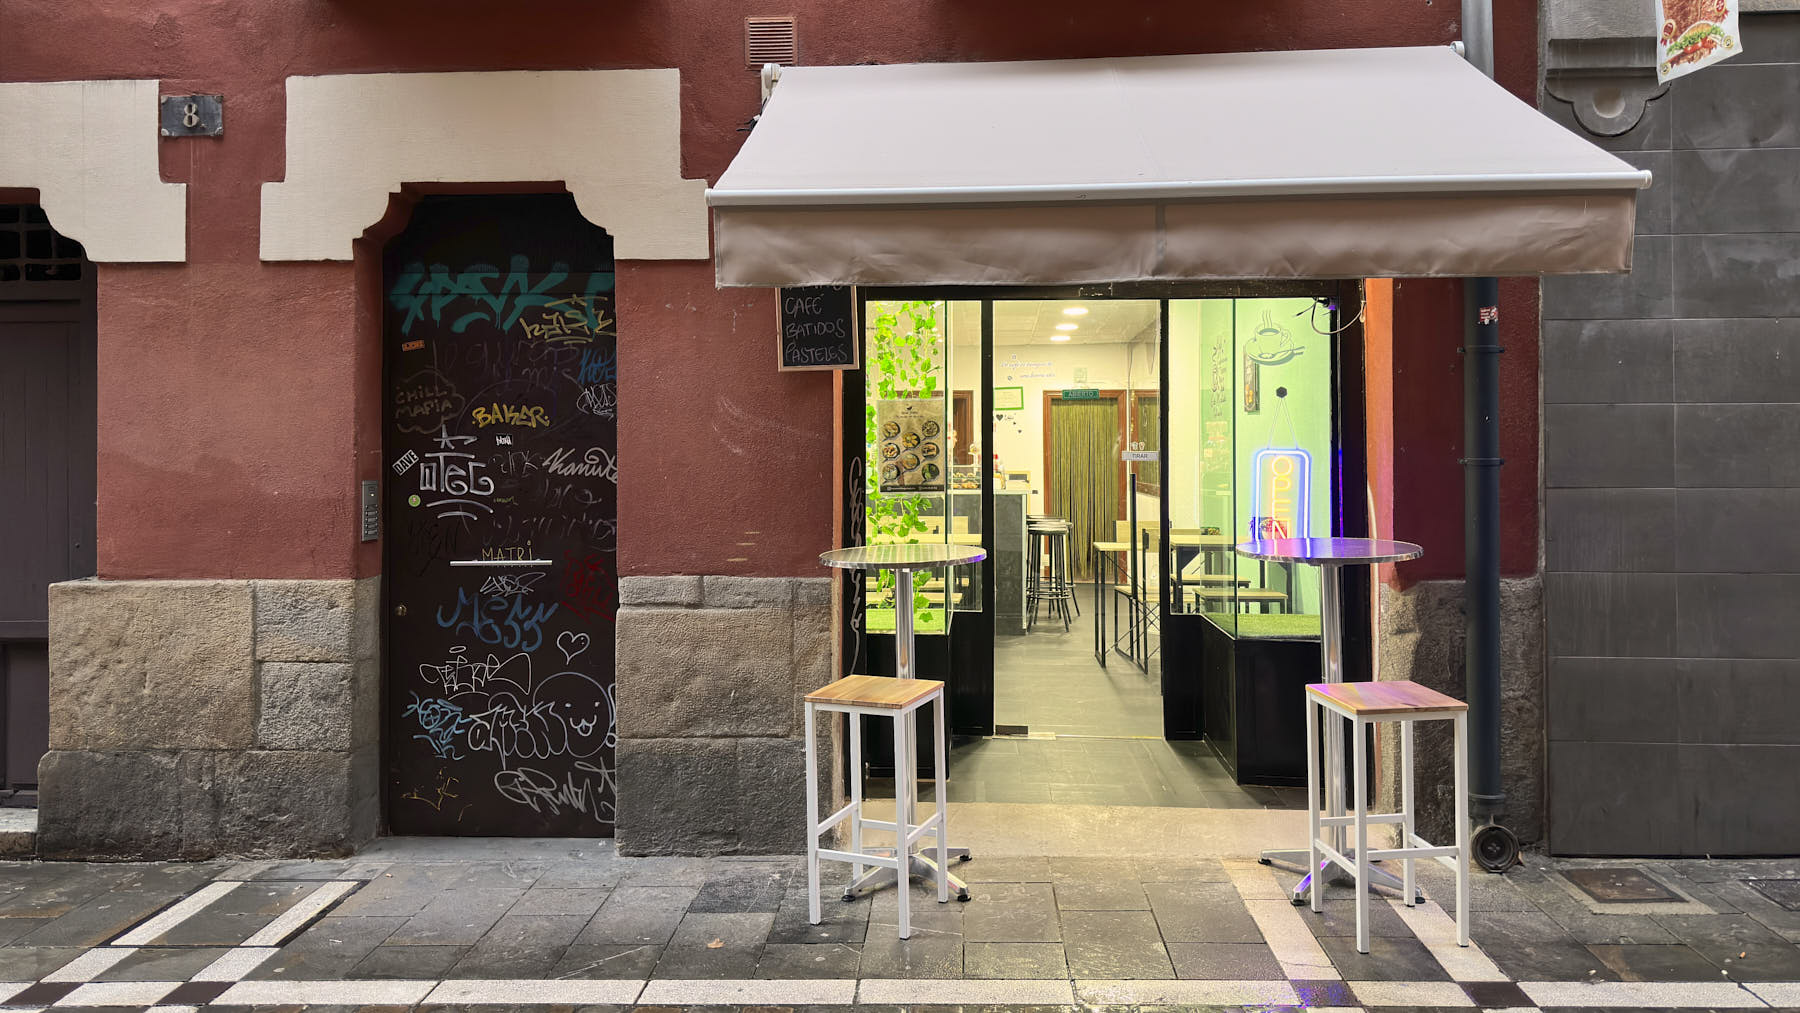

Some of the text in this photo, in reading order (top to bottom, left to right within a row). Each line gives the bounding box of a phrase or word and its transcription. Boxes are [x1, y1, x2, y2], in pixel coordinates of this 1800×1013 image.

[183, 103, 199, 128] 8
[785, 318, 846, 339] BATIDOS
[785, 342, 848, 363] PASTELES
[393, 451, 418, 474] DAVE
[1271, 455, 1293, 539] OPEN
